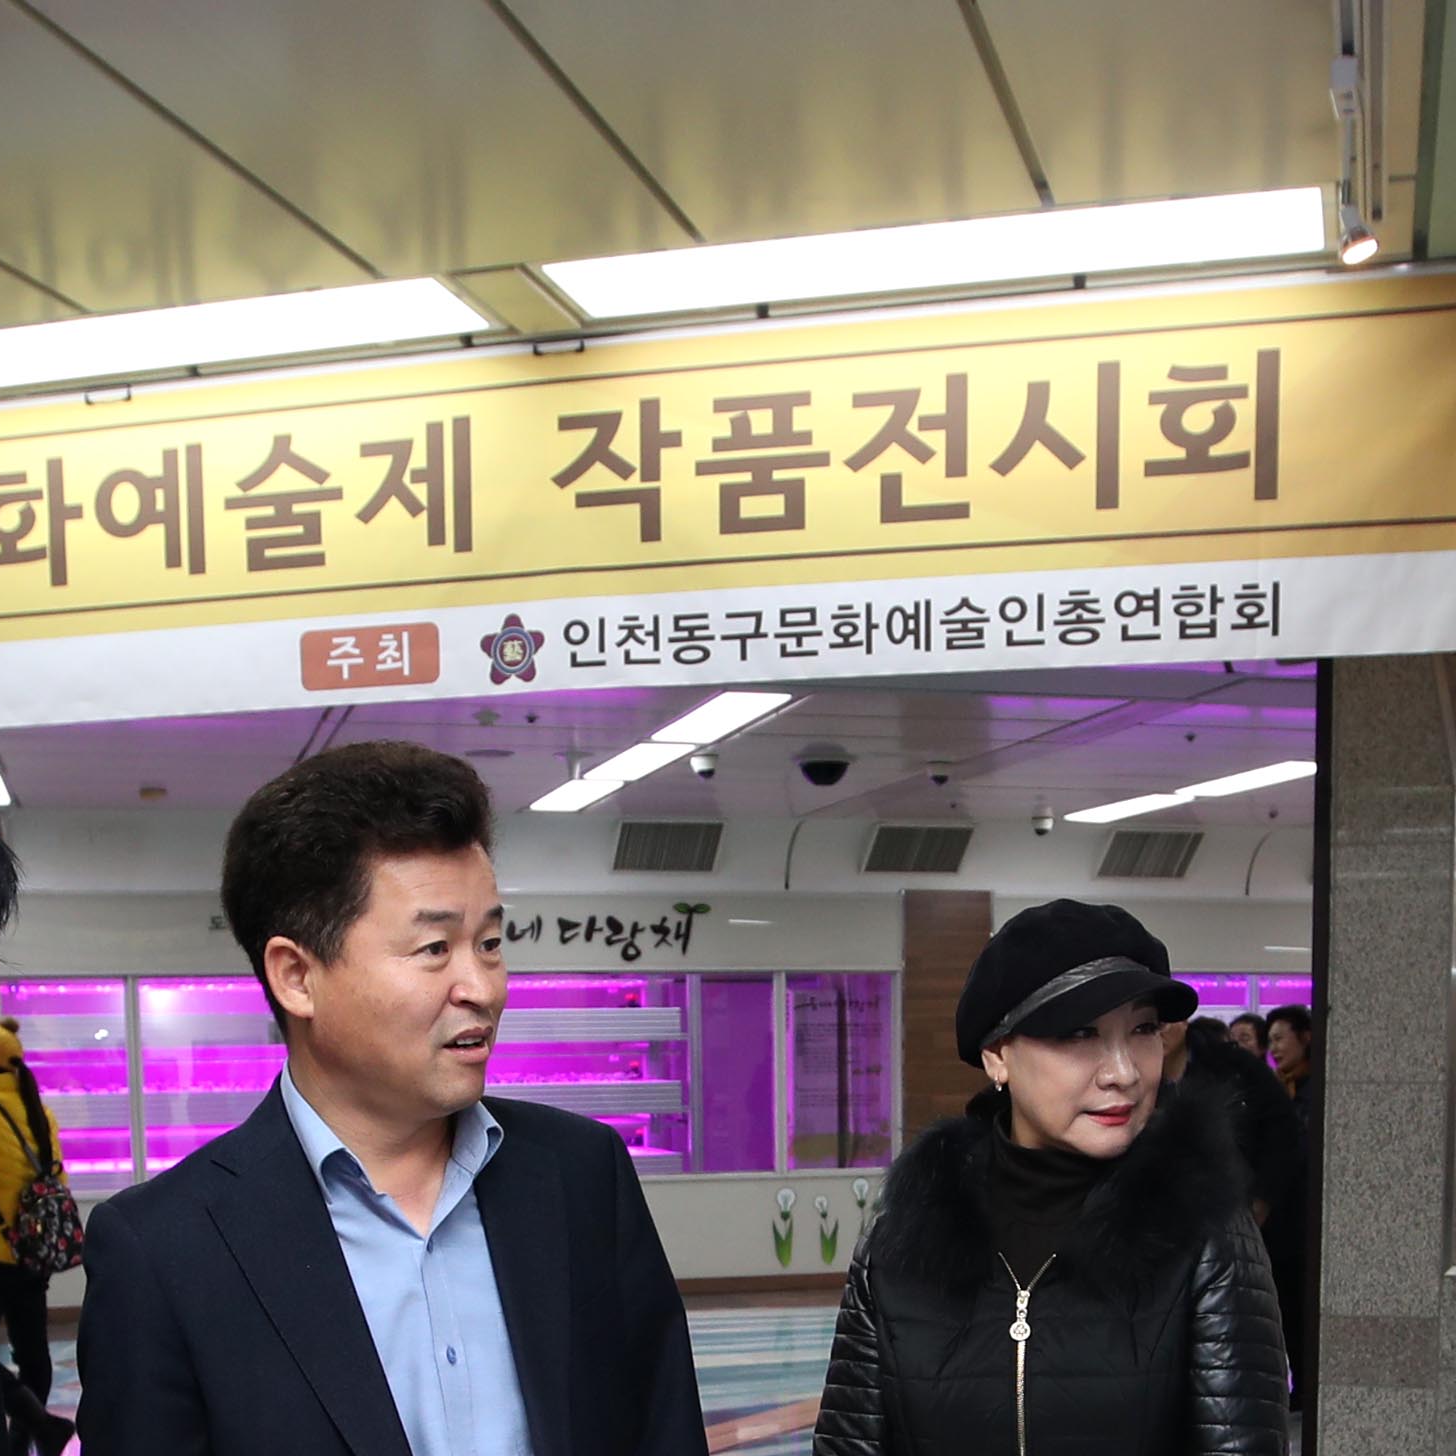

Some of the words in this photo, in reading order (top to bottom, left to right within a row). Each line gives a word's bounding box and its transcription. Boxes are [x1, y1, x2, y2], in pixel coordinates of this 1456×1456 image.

[550, 348, 1282, 543] 작품전시회
[563, 580, 1284, 668] 인천동구문화예술인총연합회
[505, 914, 542, 943] 네
[557, 906, 694, 962] 다랑채
